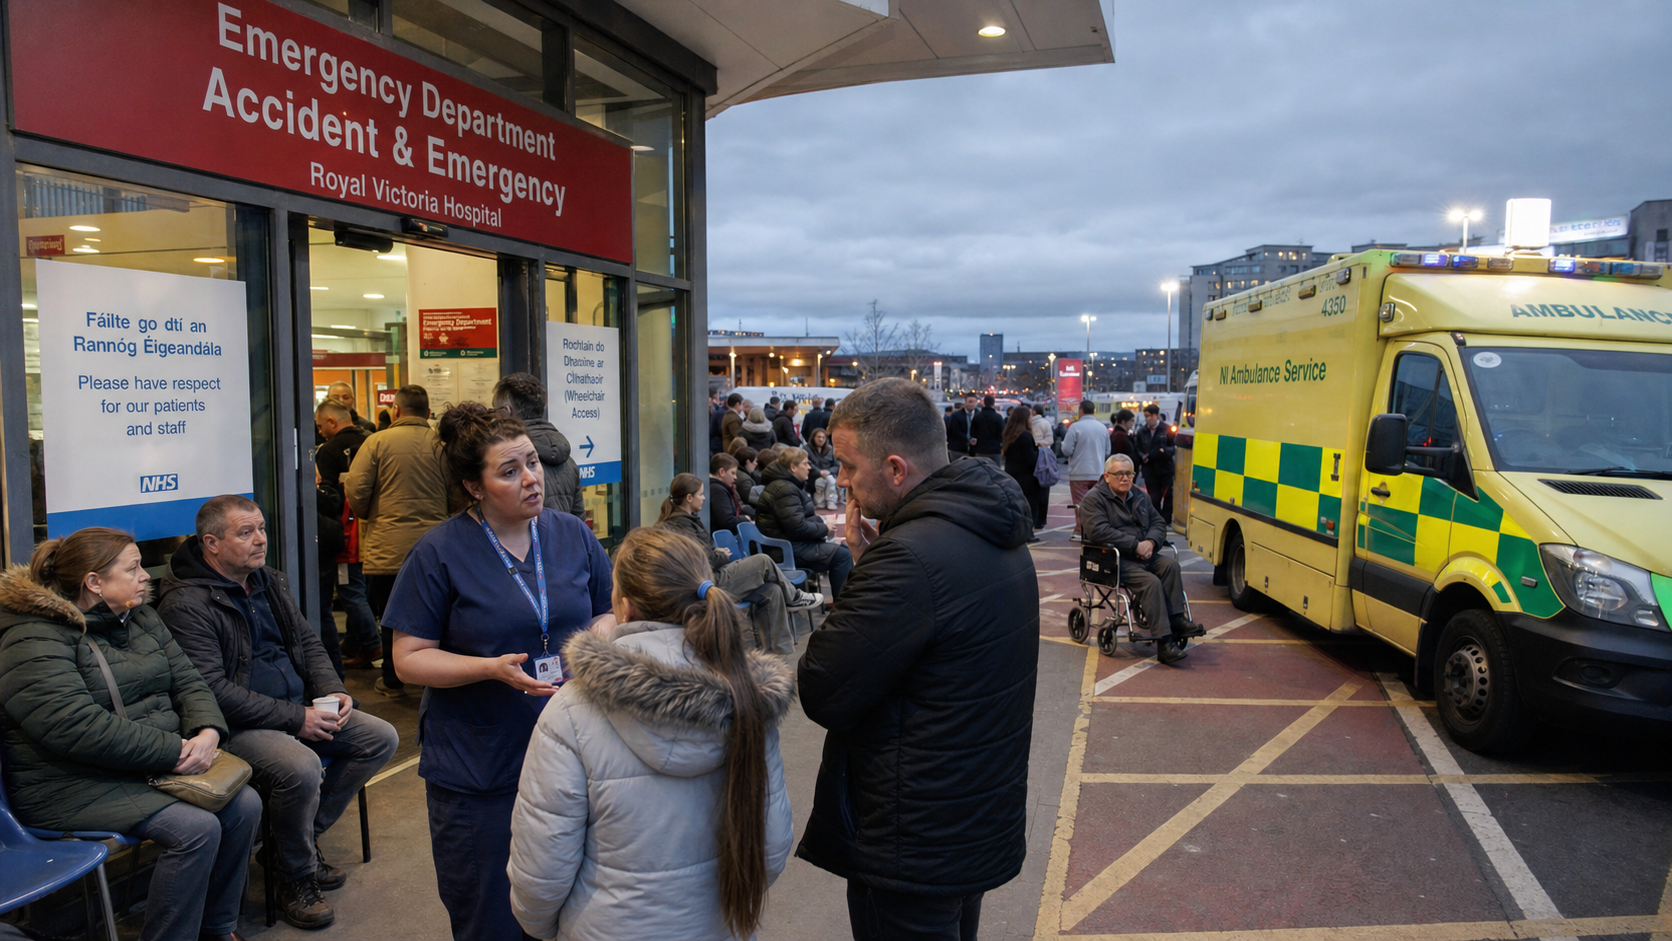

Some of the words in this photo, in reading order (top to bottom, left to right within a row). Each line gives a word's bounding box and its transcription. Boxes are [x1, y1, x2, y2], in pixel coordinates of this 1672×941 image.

[217, 2, 412, 118] Emergency
[422, 80, 556, 161] Department
[202, 66, 379, 158] Accident
[392, 125, 415, 168] &
[428, 135, 566, 217] Emergency
[310, 161, 366, 199] Royal
[372, 176, 439, 214] Victoria
[444, 194, 502, 228] Hospital
[1321, 295, 1347, 317] 4350
[86, 311, 131, 330] Fáilte
[138, 318, 158, 333] go
[165, 316, 184, 332] dtí
[190, 320, 207, 333] an
[73, 336, 138, 357] Rannóg
[143, 335, 222, 358] Éigeandála
[1220, 365, 1229, 385] NI
[1229, 363, 1281, 385] Ambulance
[1283, 357, 1327, 383] Service
[78, 375, 129, 390] Please
[134, 376, 168, 390] have
[172, 377, 221, 393] respect
[101, 398, 121, 413] for
[126, 401, 149, 413] our
[154, 398, 206, 415] patients
[126, 421, 153, 436] and
[158, 420, 187, 435] staff
[141, 474, 178, 492] NHS
[579, 465, 596, 479] NHS
